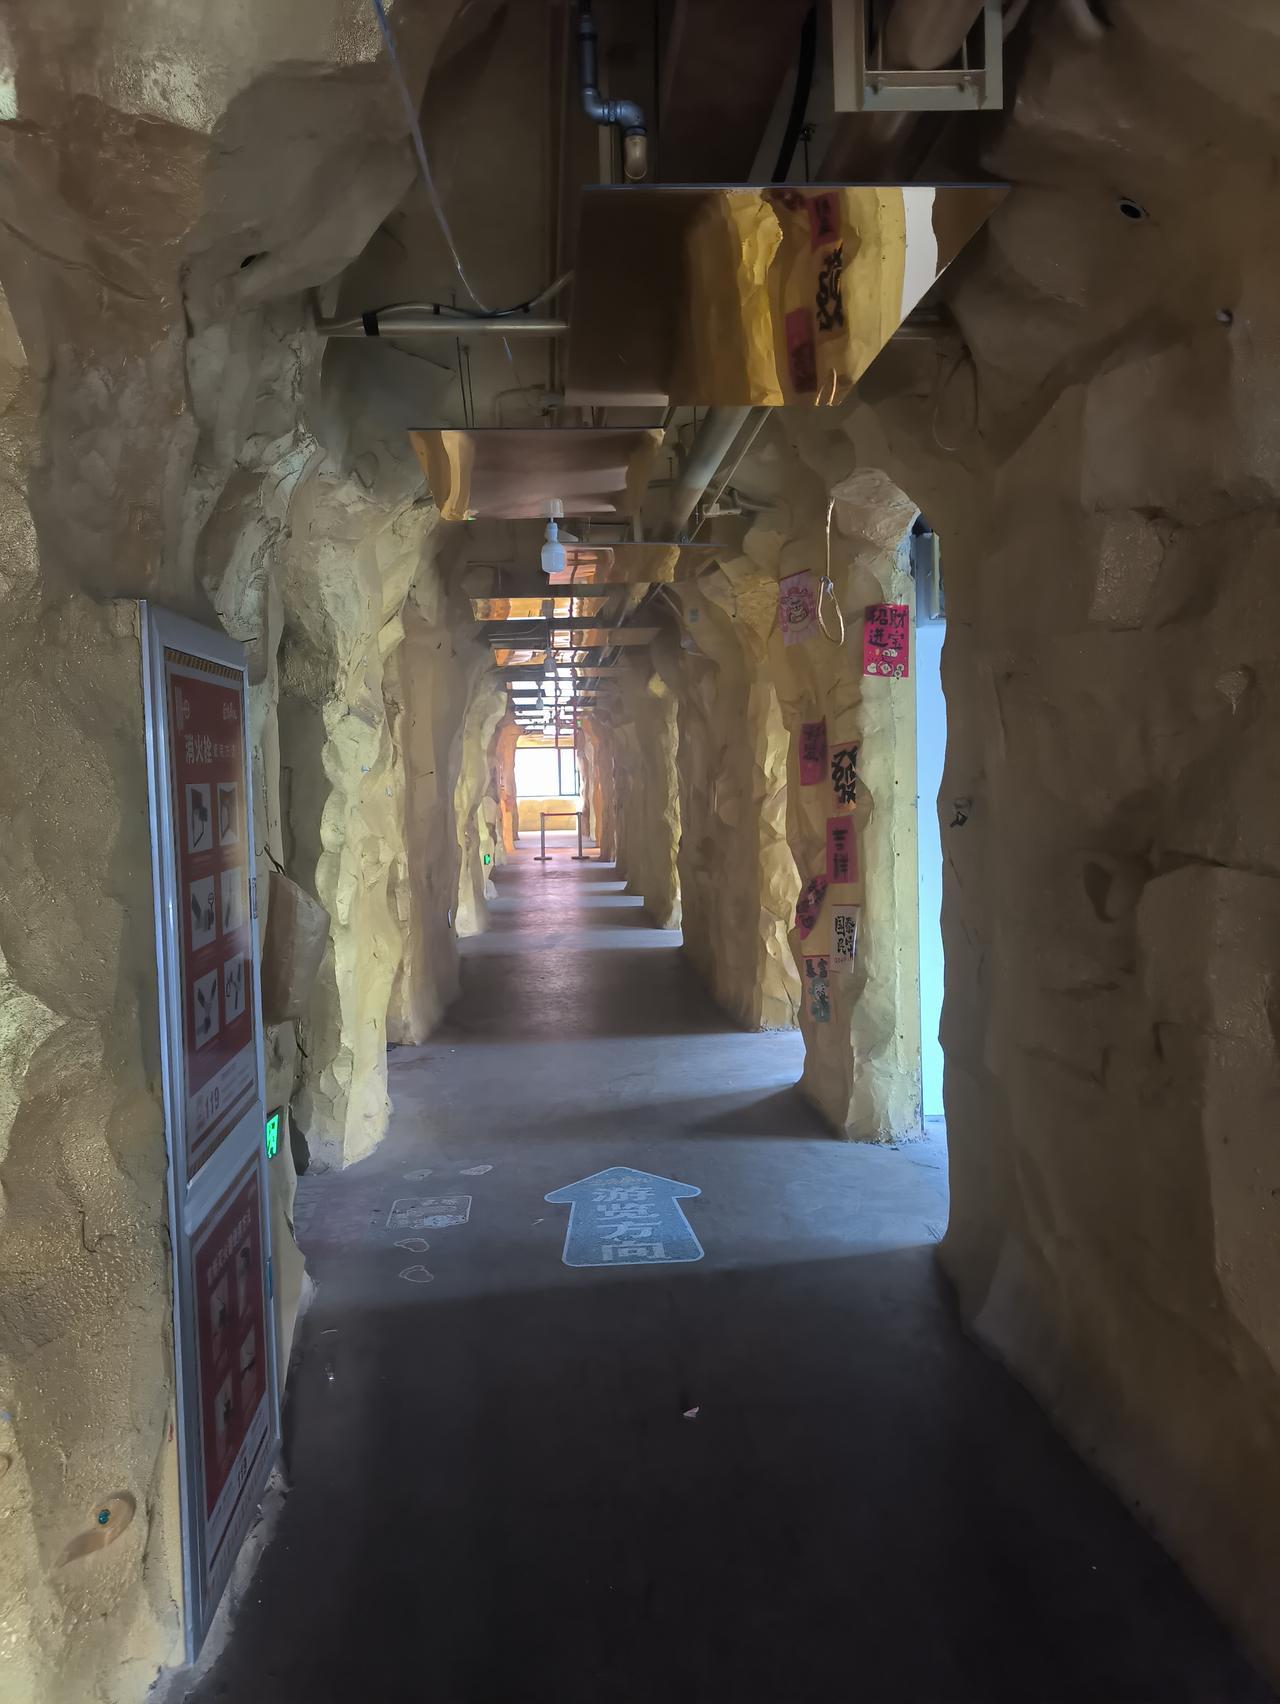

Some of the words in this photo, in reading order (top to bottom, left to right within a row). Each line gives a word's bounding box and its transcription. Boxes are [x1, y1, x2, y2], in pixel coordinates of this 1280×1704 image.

[867, 607, 905, 628] 招财
[869, 627, 904, 650] 进宝
[592, 1186, 671, 1260] 游览方向
